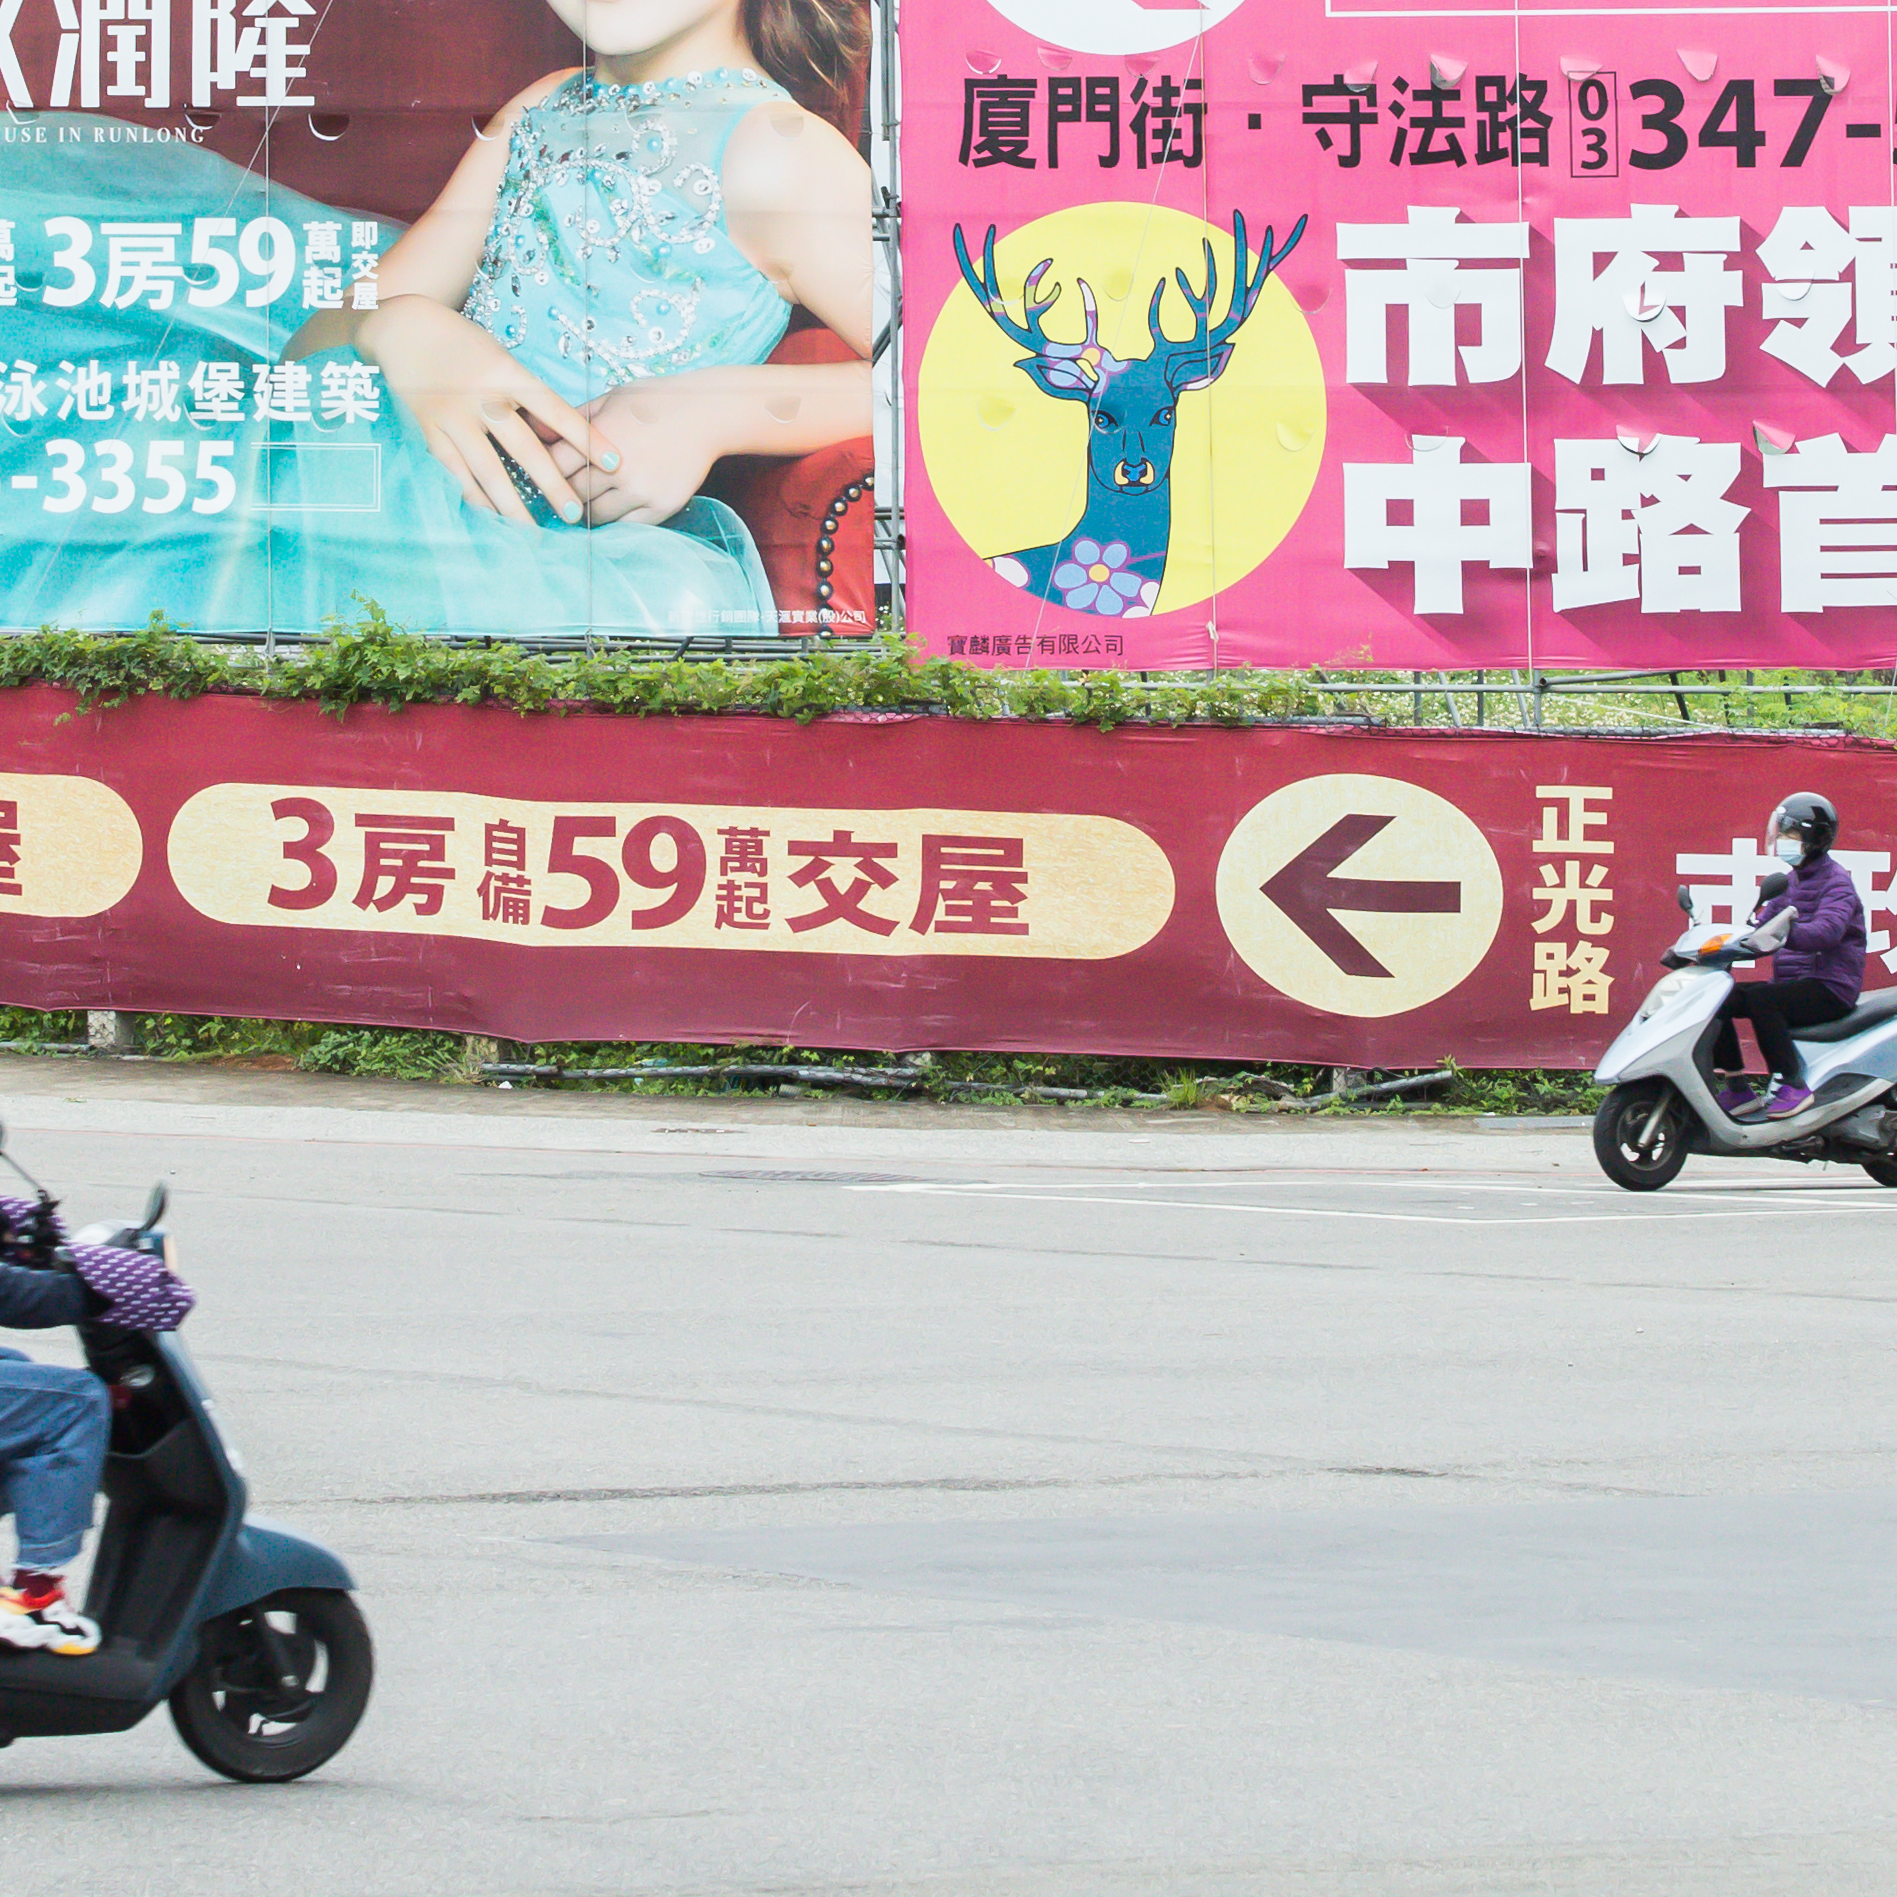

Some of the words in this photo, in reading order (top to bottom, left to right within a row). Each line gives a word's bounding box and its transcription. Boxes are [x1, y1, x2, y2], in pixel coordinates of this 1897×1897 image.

[57, 125, 84, 143] IN
[92, 125, 206, 144] RUNLONG
[1528, 785, 1616, 1015] 正光路
